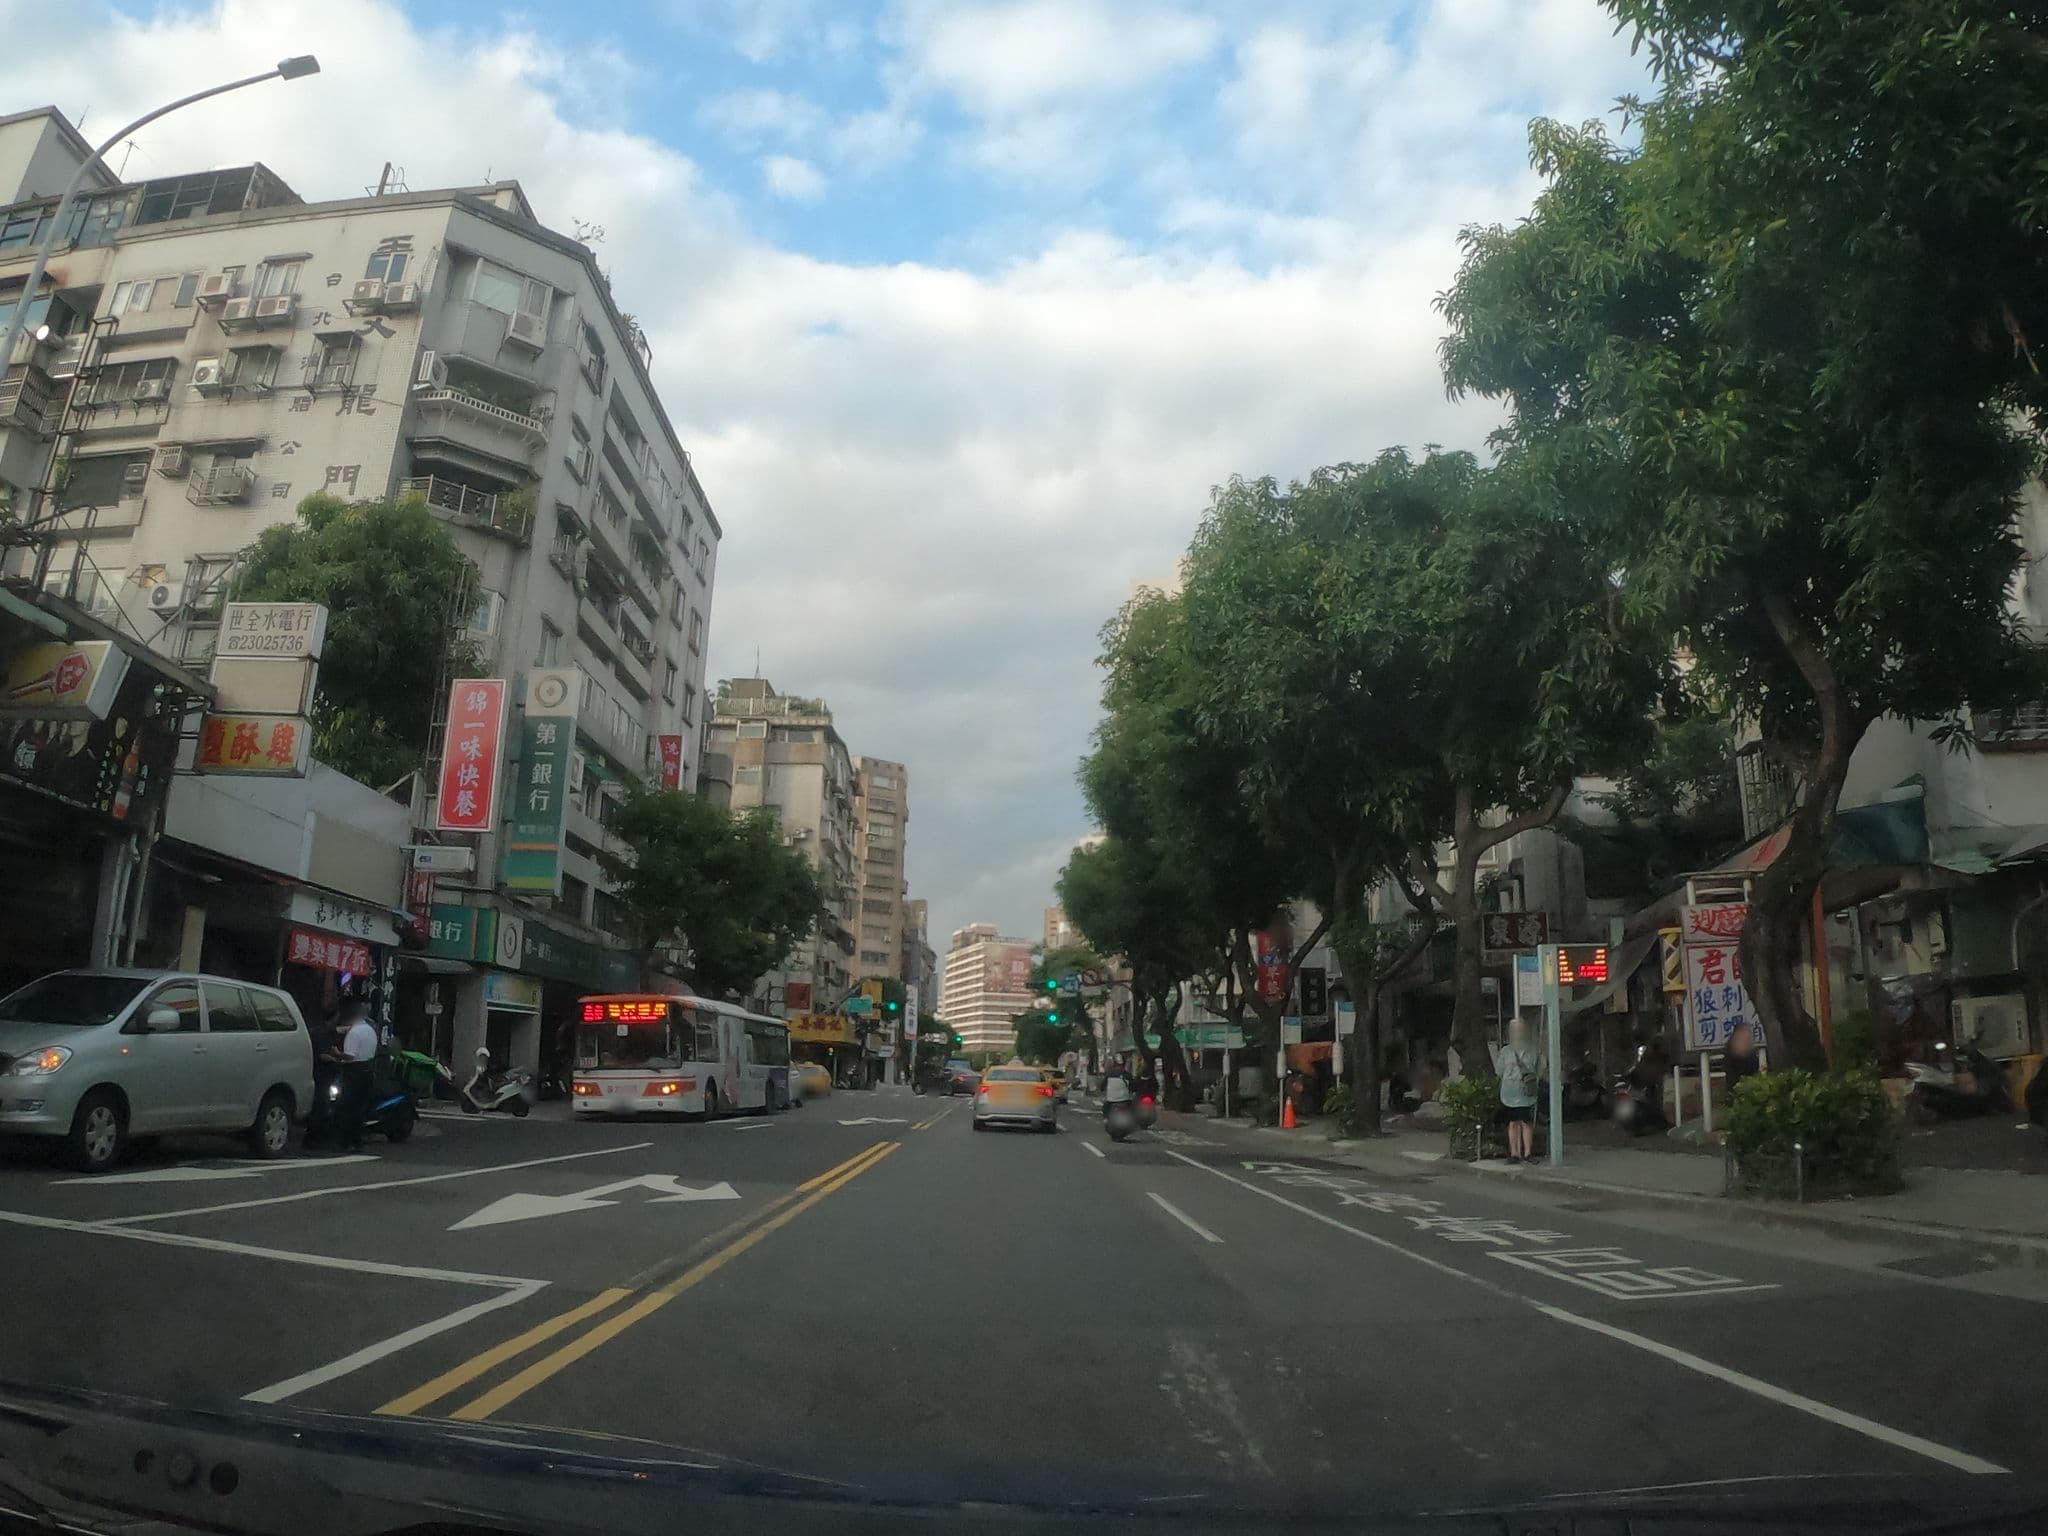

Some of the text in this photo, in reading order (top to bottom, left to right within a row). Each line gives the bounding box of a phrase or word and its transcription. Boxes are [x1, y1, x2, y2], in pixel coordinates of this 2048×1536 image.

[229, 609, 312, 631] 世全水電行
[240, 635, 304, 651] 23025736
[529, 722, 557, 812] 第一銀行
